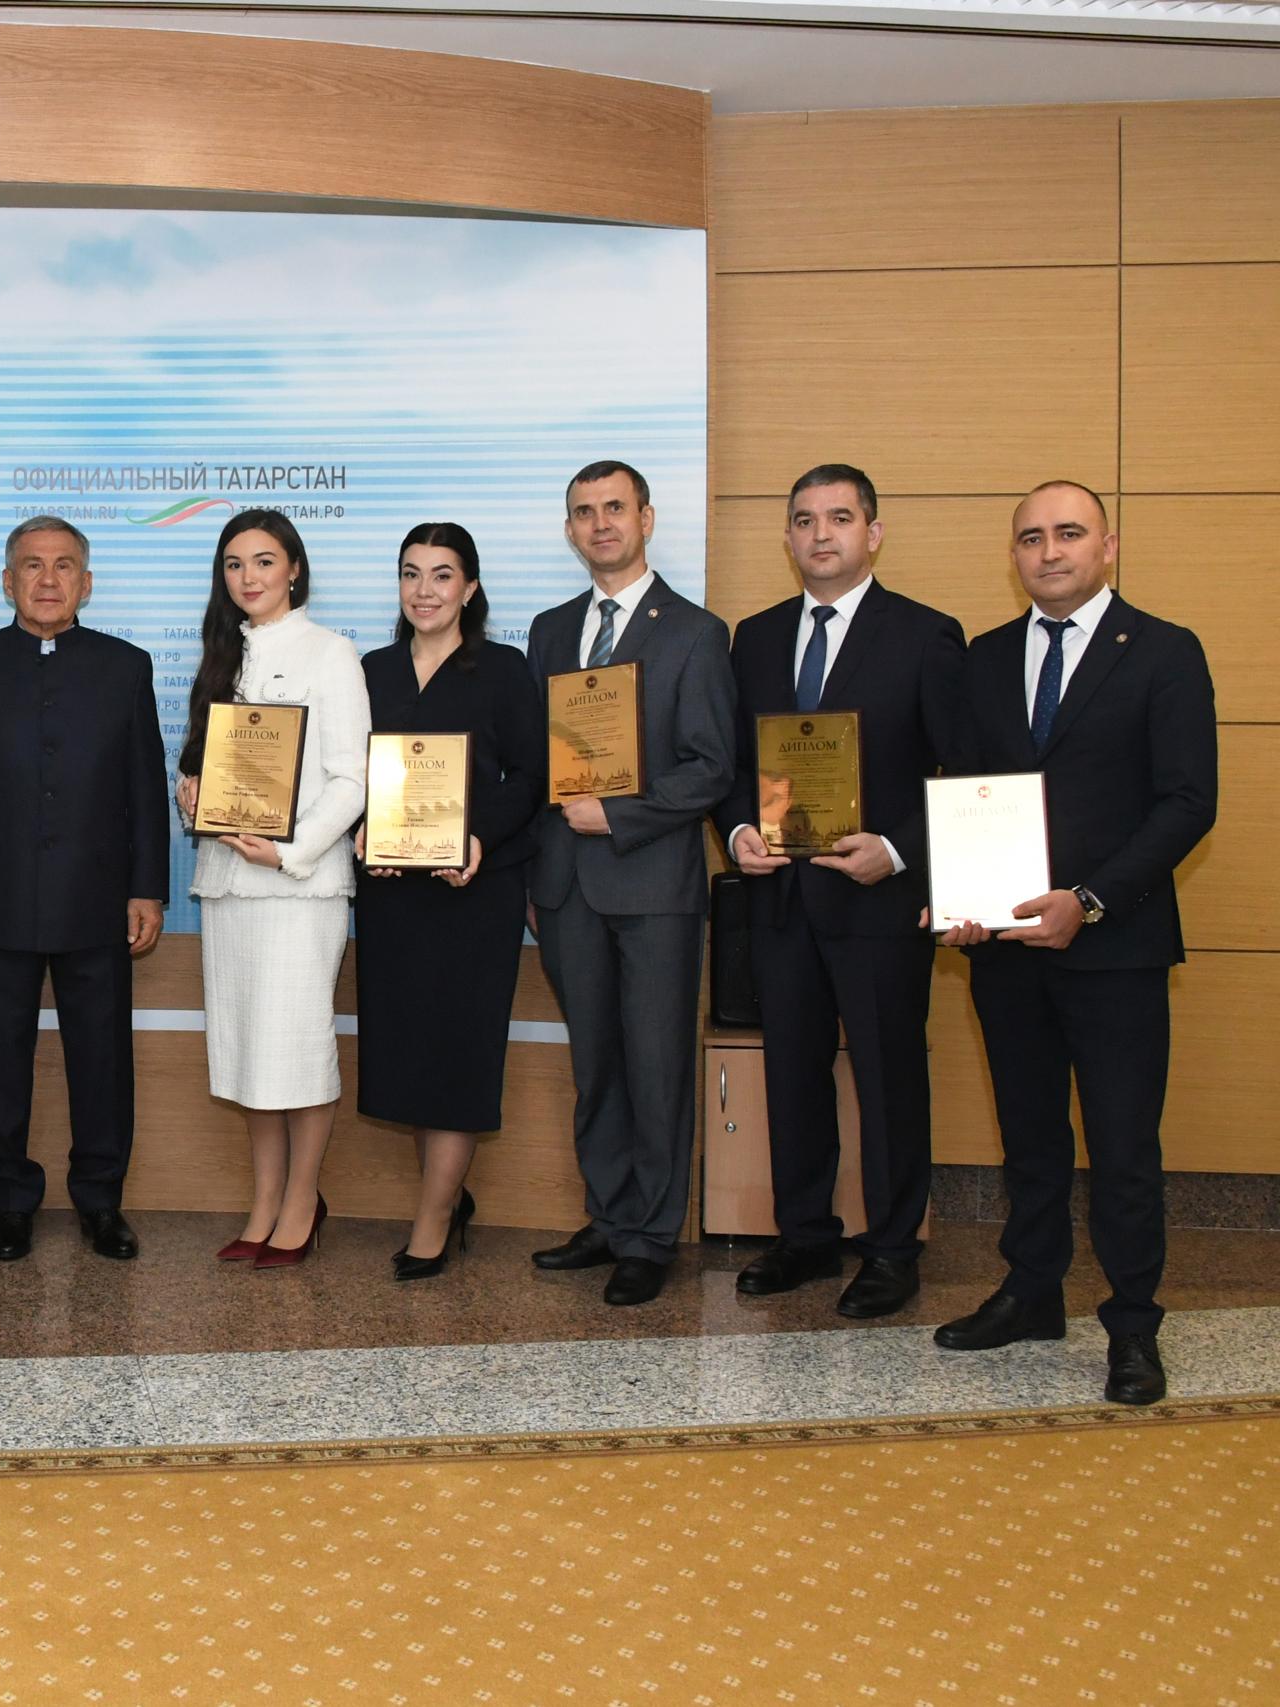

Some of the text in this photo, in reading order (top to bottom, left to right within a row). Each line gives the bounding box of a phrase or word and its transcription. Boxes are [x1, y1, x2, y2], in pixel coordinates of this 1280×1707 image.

[13, 462, 346, 495] ОФИЦИАЛЬНЫЙ ТАТАРСТАН
[566, 691, 617, 707] ДИПЛОМ
[226, 729, 280, 740] ДИПЛОМ
[778, 741, 837, 753] ДИПЛОМ
[404, 759, 445, 769] ПЛОМ
